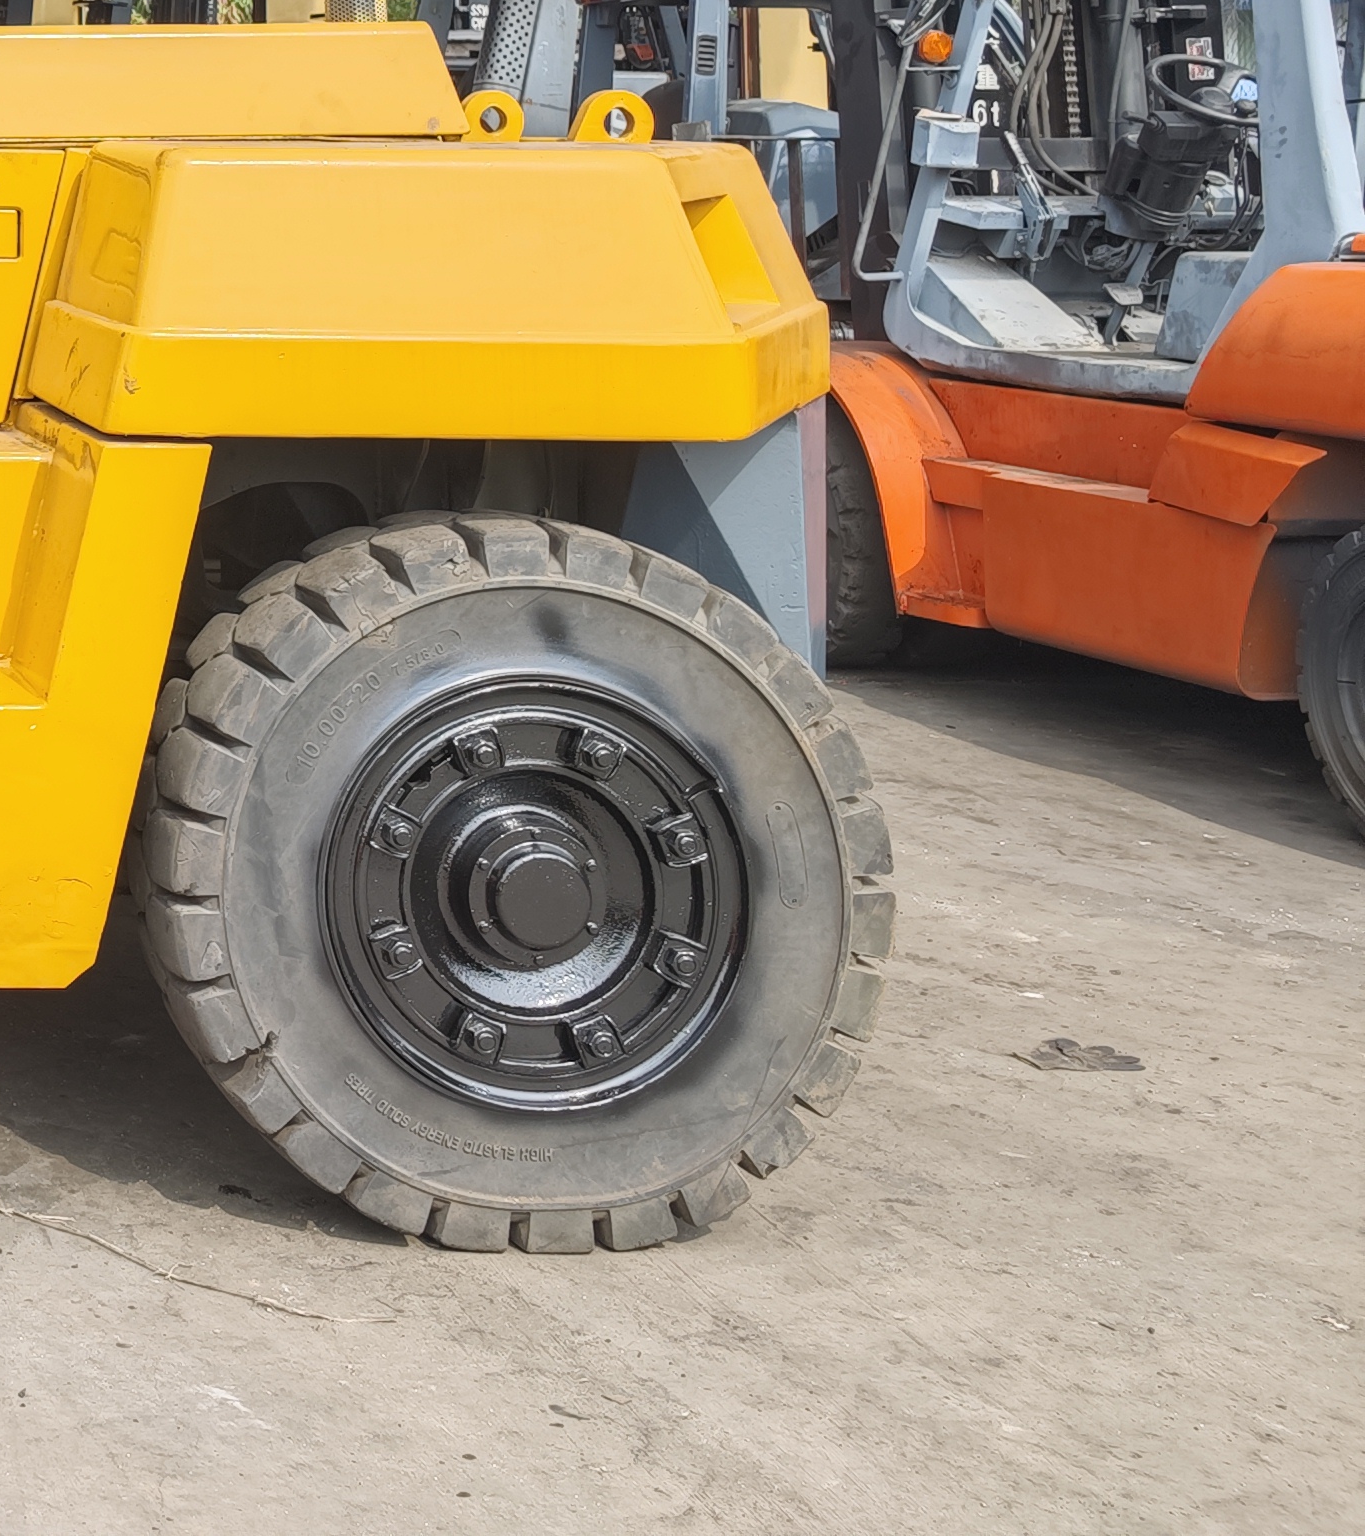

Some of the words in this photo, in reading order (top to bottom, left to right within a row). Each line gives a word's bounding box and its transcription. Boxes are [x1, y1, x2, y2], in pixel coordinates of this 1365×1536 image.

[296, 670, 382, 770] 10.00-20
[343, 1071, 379, 1106] TIRES
[374, 1098, 413, 1128] SOLID
[409, 1120, 462, 1152] ENERGY
[463, 1139, 517, 1163] ELASTIC
[519, 1146, 555, 1164] HIGH
